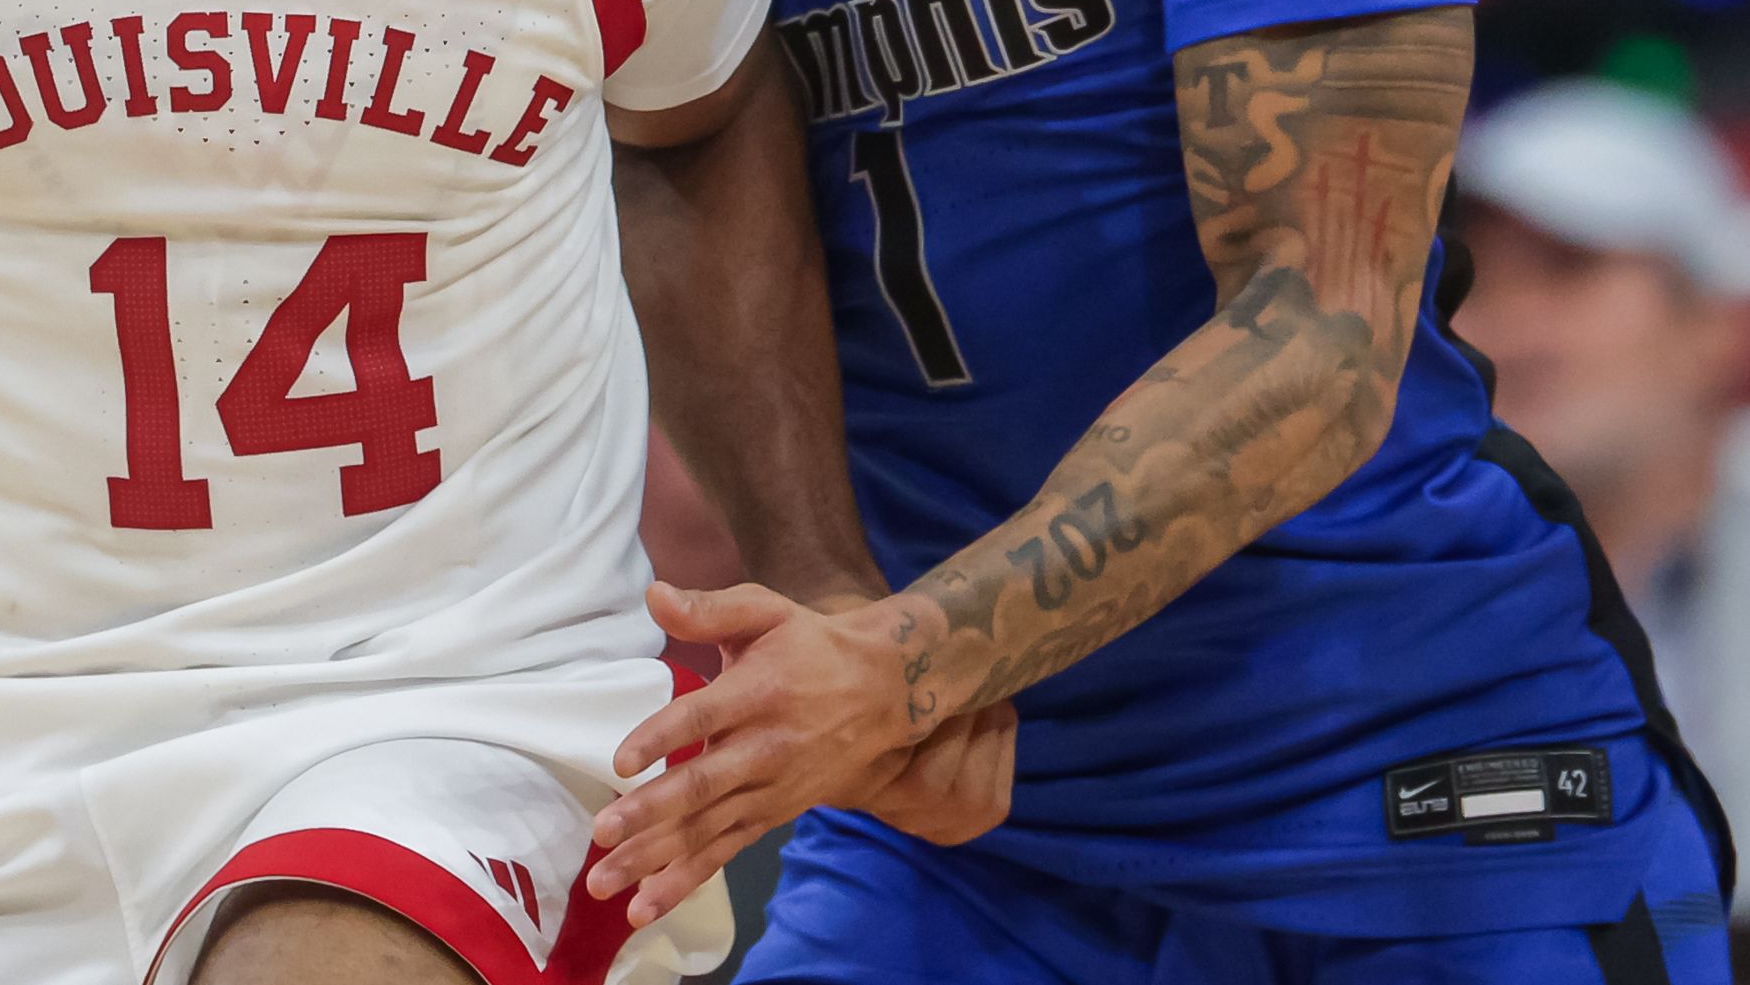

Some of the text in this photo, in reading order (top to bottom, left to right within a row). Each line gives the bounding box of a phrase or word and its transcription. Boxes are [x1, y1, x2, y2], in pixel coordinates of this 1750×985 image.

[849, 128, 973, 392] 1
[89, 232, 442, 530] 14
[1005, 481, 1147, 611] 202
[1556, 768, 1588, 799] 42
